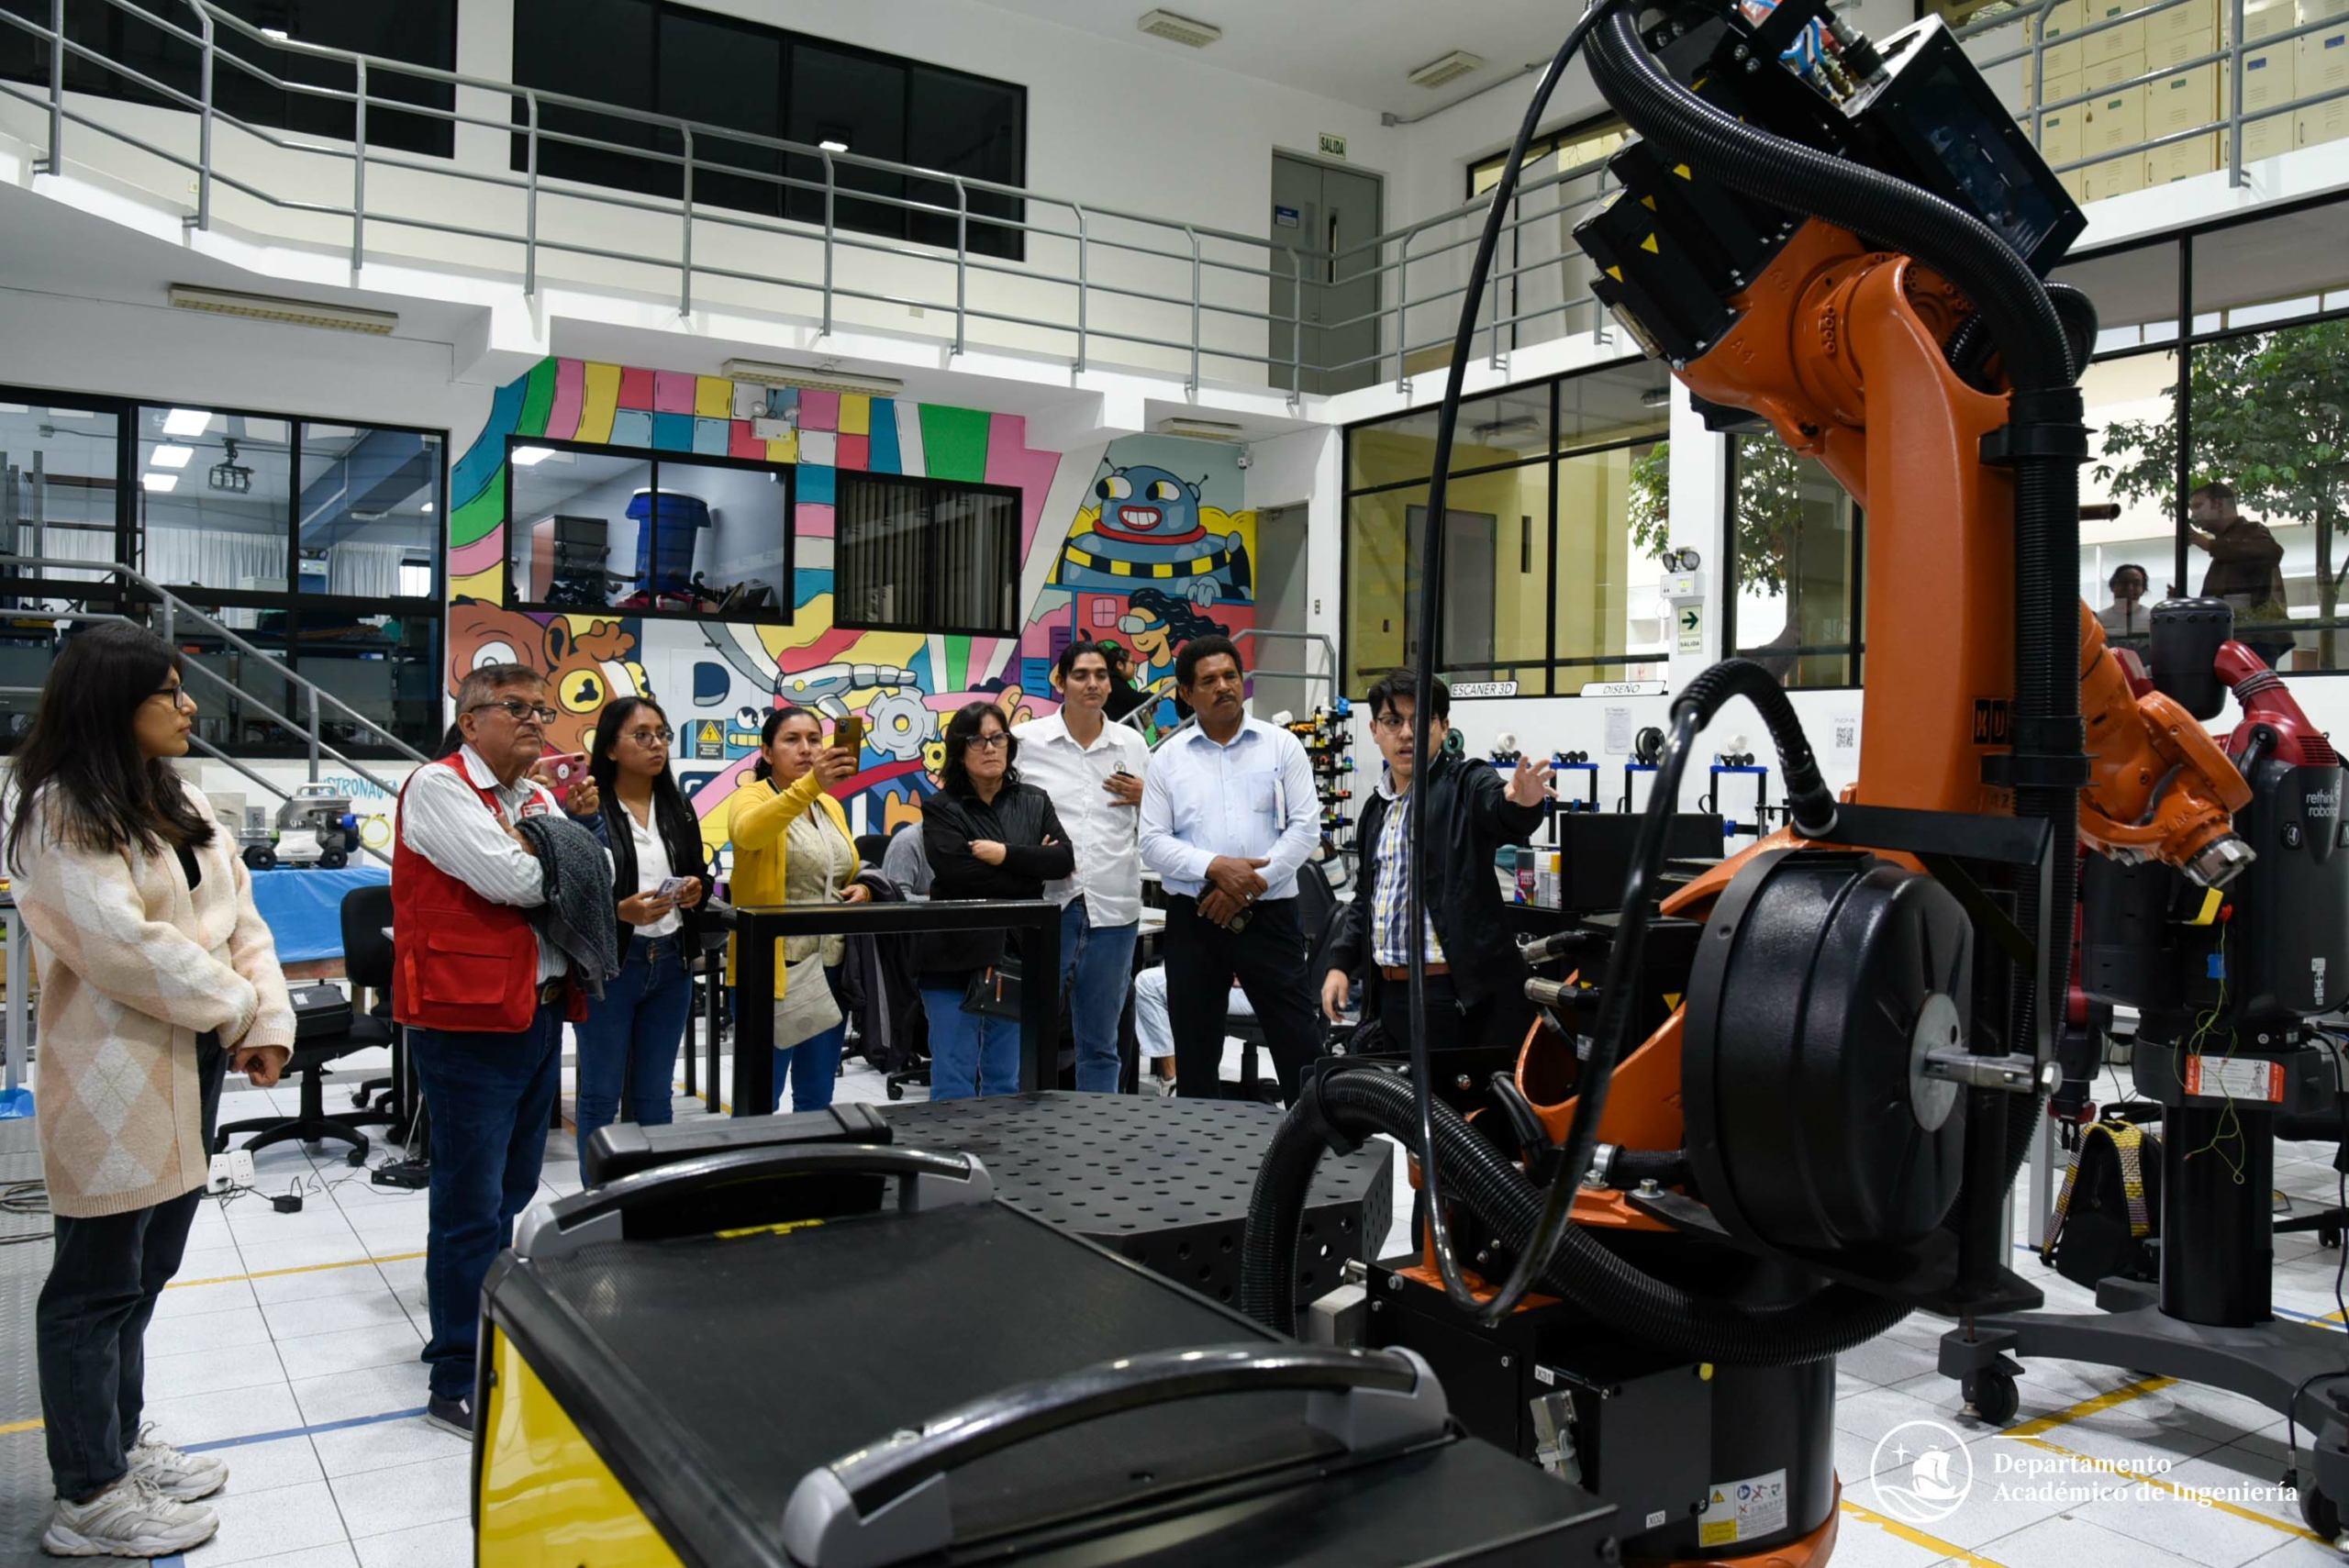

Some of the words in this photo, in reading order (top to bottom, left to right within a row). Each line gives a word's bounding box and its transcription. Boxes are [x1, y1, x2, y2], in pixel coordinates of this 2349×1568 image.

[1321, 137, 1344, 157] SALIDA
[1680, 639, 1700, 648] SALIDA
[1453, 684, 1497, 696] ESCANER
[1498, 683, 1513, 695] 3D
[1603, 683, 1641, 695] DISEÑO
[1714, 752, 1721, 764] 6
